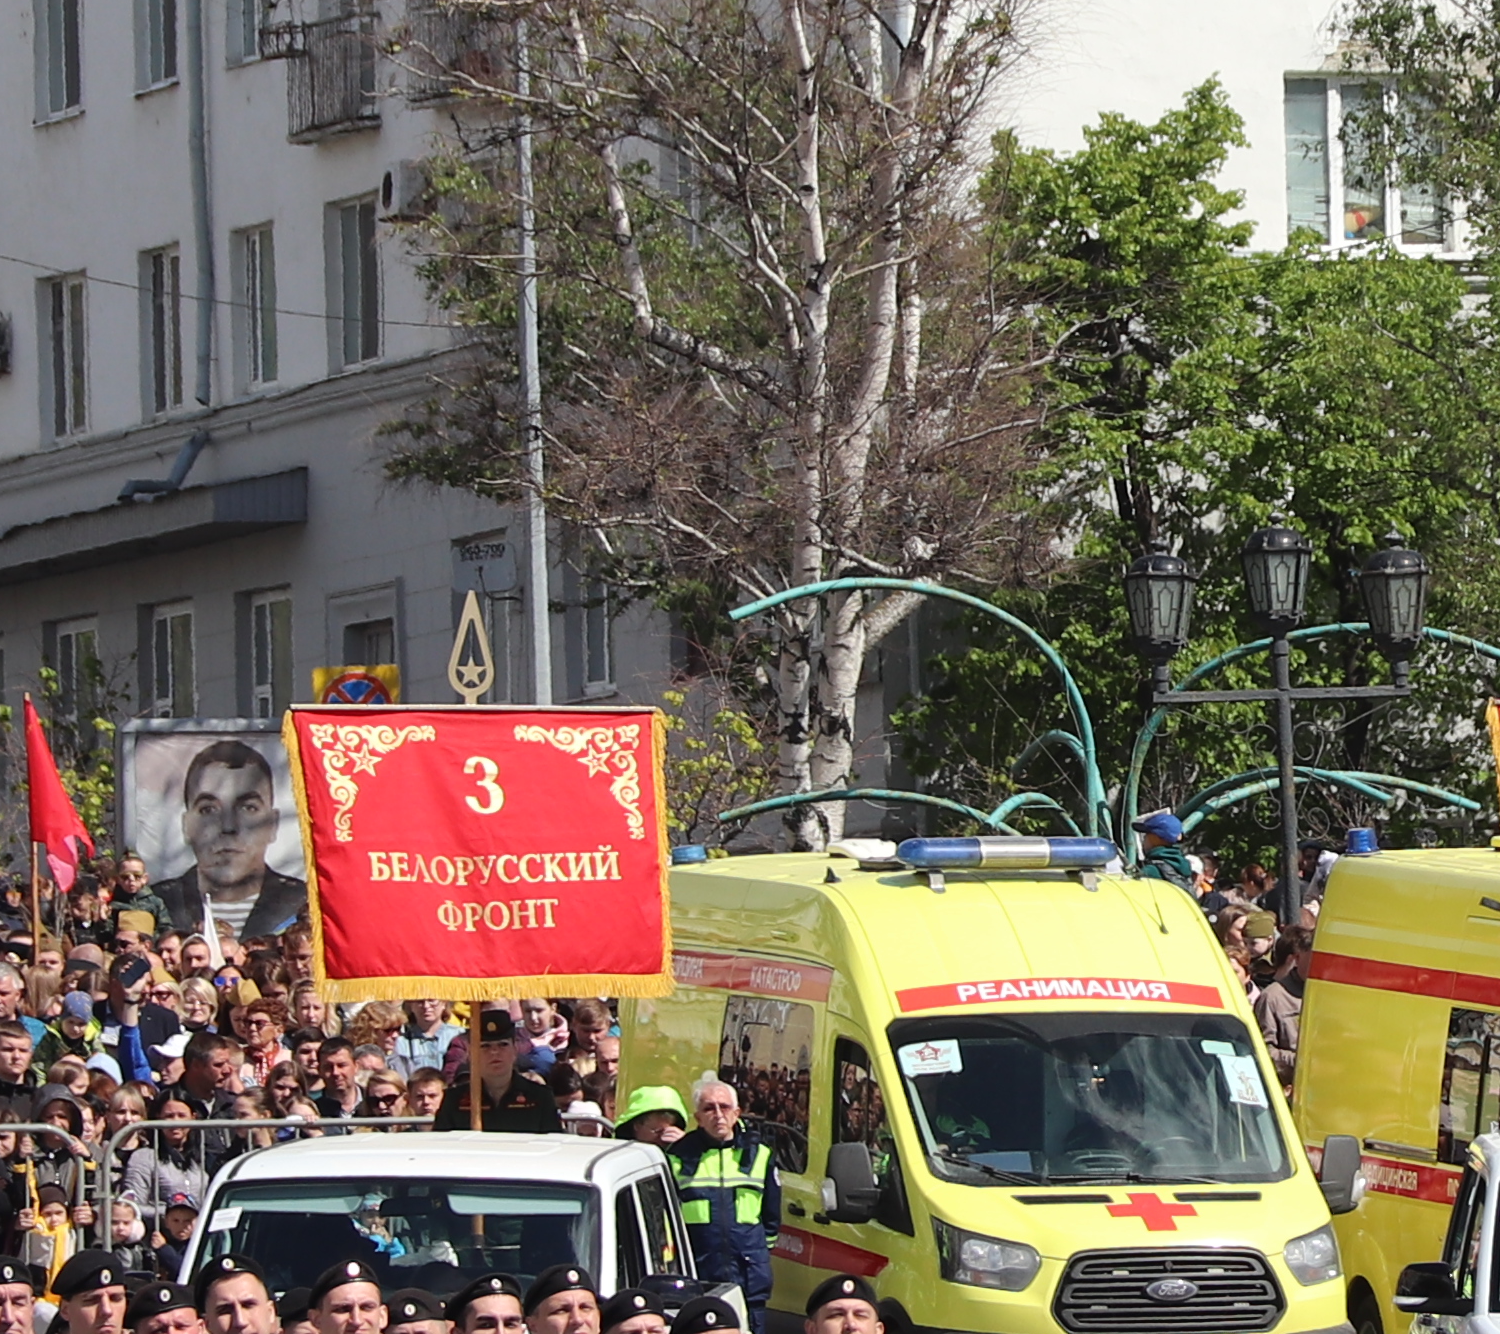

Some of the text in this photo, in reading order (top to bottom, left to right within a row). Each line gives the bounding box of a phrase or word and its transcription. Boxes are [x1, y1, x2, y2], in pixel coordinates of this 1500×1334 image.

[463, 755, 505, 814] 3
[368, 845, 622, 886] БЕЛОРУССКИЙ
[437, 899, 558, 932] ФРОНТ
[750, 965, 801, 992] КАТАСТРОФ
[957, 981, 1171, 1002] РЕАНИМАЦИЯ
[1158, 1282, 1187, 1296] Ford
